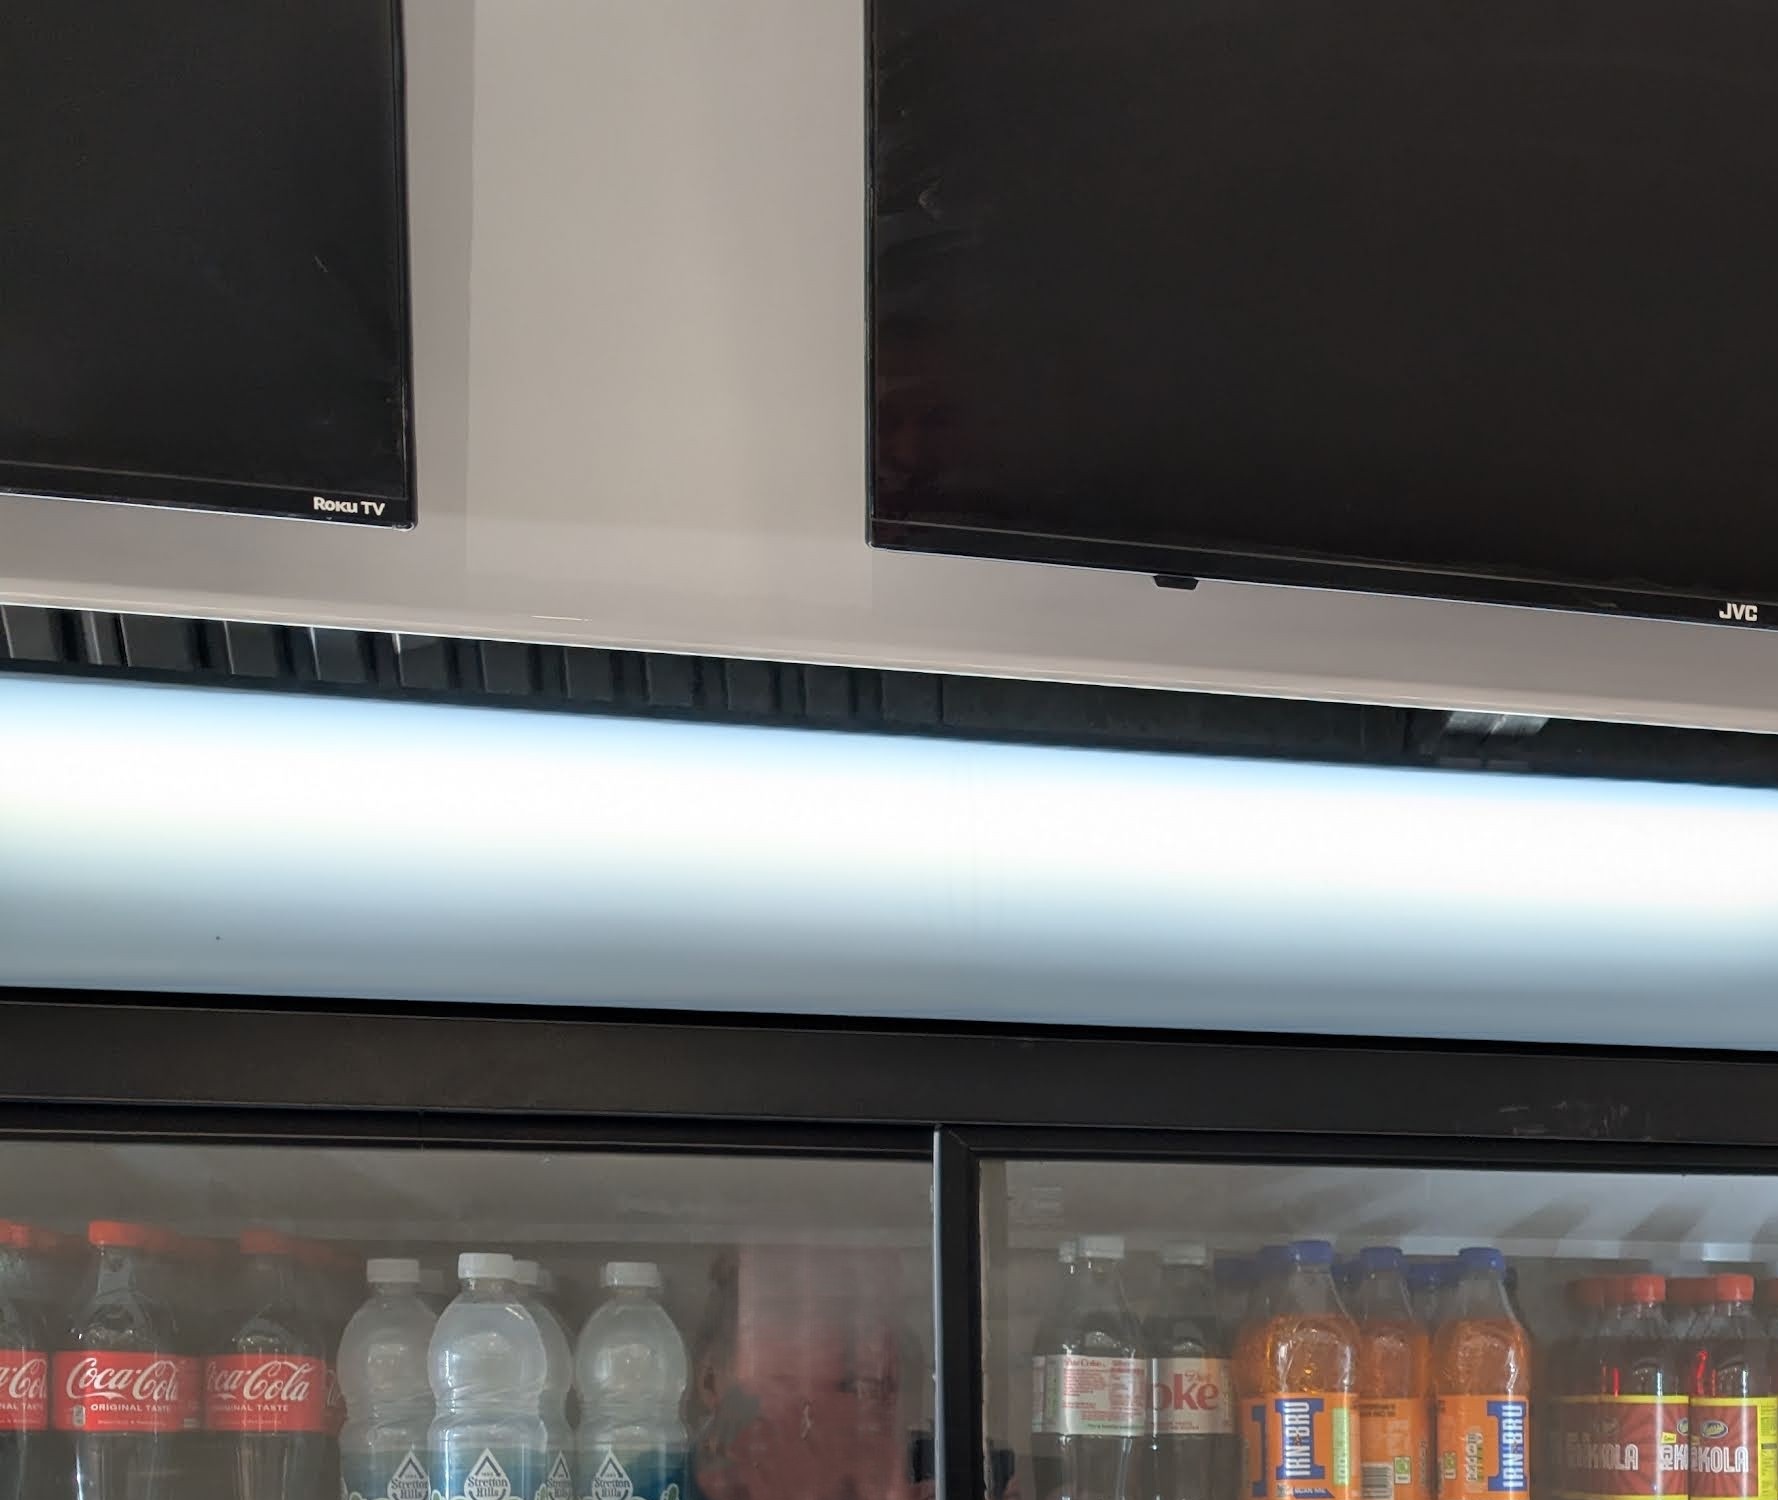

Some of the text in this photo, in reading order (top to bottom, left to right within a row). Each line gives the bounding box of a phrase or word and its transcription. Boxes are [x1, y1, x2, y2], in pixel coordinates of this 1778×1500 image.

[313, 496, 385, 516] Roku TV
[1719, 603, 1758, 621] JVC
[1699, 1445, 1750, 1473] KOLA
[468, 1477, 508, 1489] Stretton
[594, 1478, 630, 1489] Stretton
[476, 1487, 499, 1497] Hills
[601, 1487, 622, 1497] Hills
